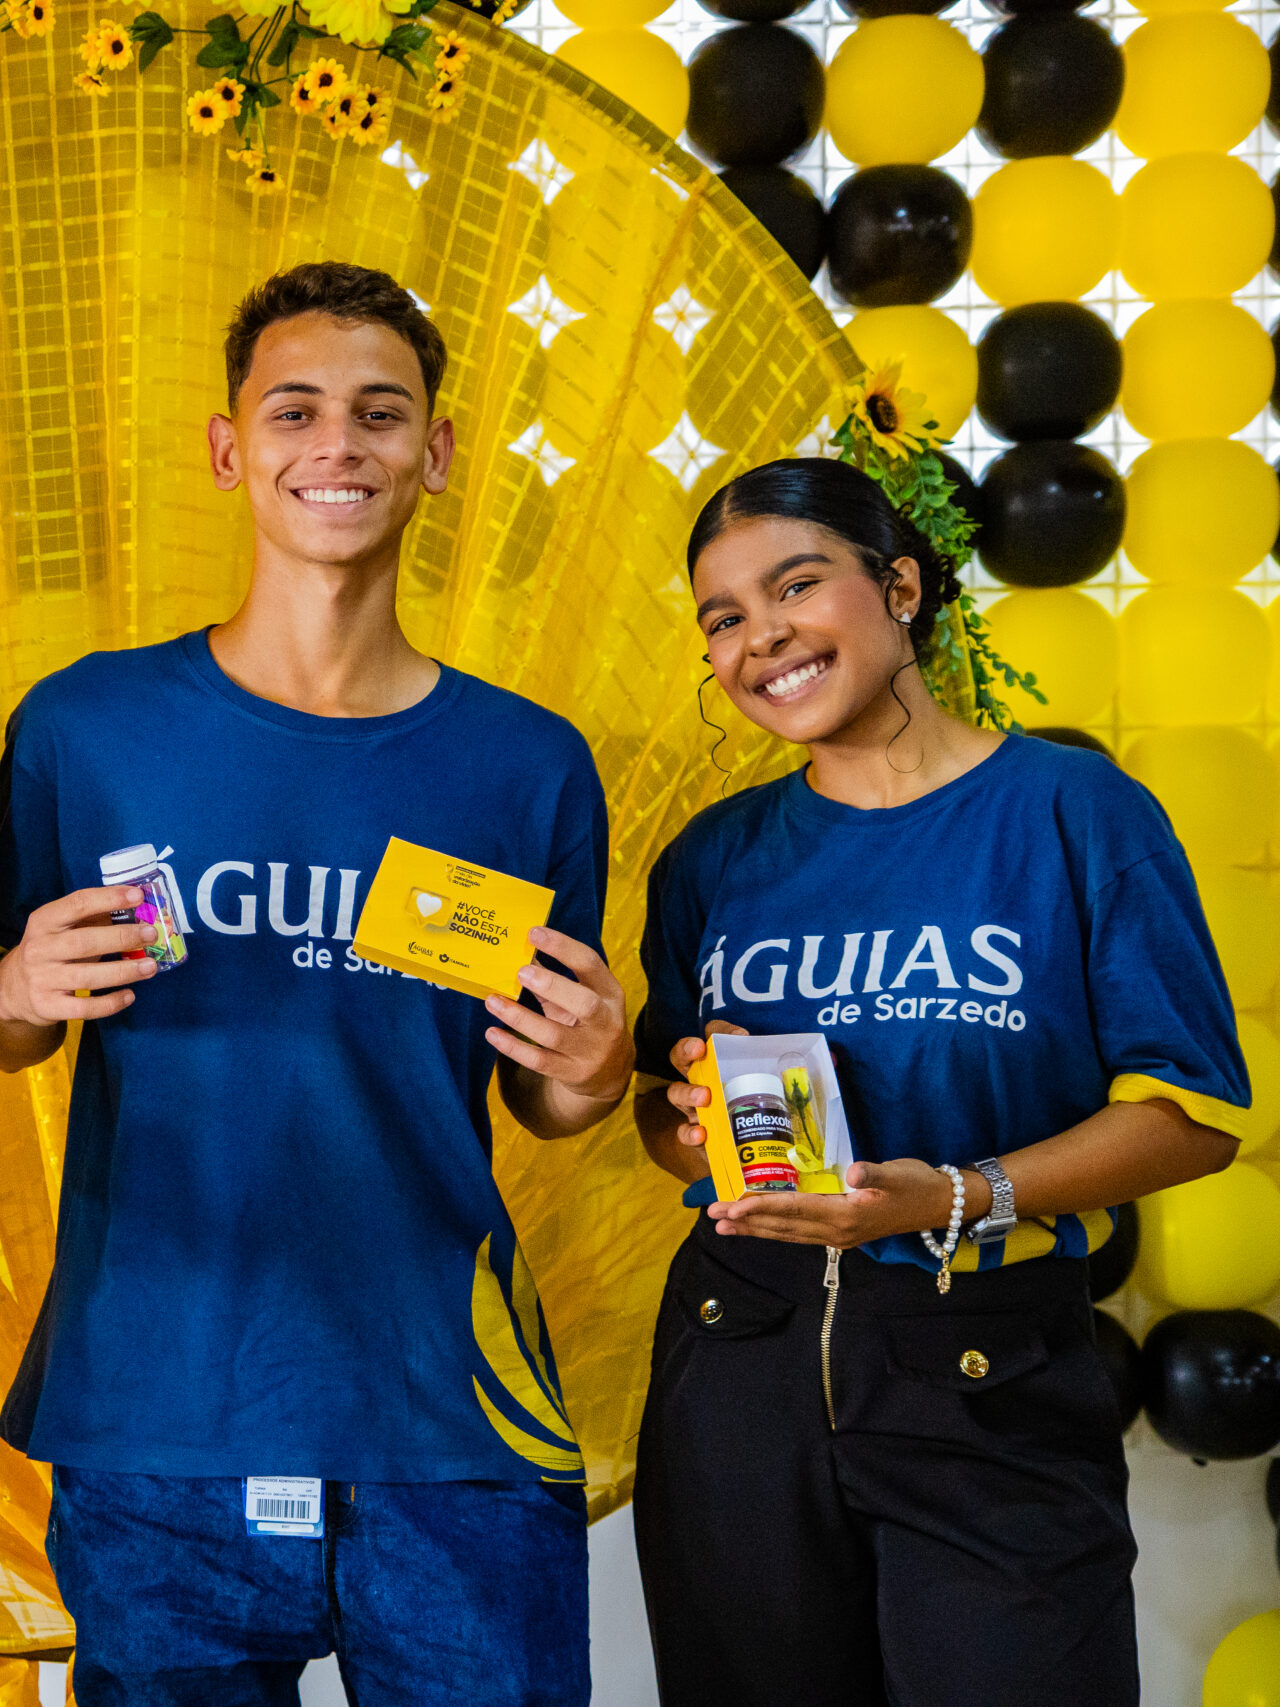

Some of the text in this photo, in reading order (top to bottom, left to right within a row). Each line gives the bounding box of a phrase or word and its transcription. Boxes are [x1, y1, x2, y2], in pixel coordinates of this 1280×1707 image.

[154, 845, 362, 940] ÁGUI
[456, 901, 496, 921] #VOCÊ
[449, 922, 500, 946] SOZINHO
[452, 912, 508, 938] NÃO ESTÁ
[292, 940, 333, 969] de
[699, 924, 1023, 1017] ÁGUIAS
[817, 994, 1026, 1031] de Sarzedo
[740, 1146, 755, 1164] G
